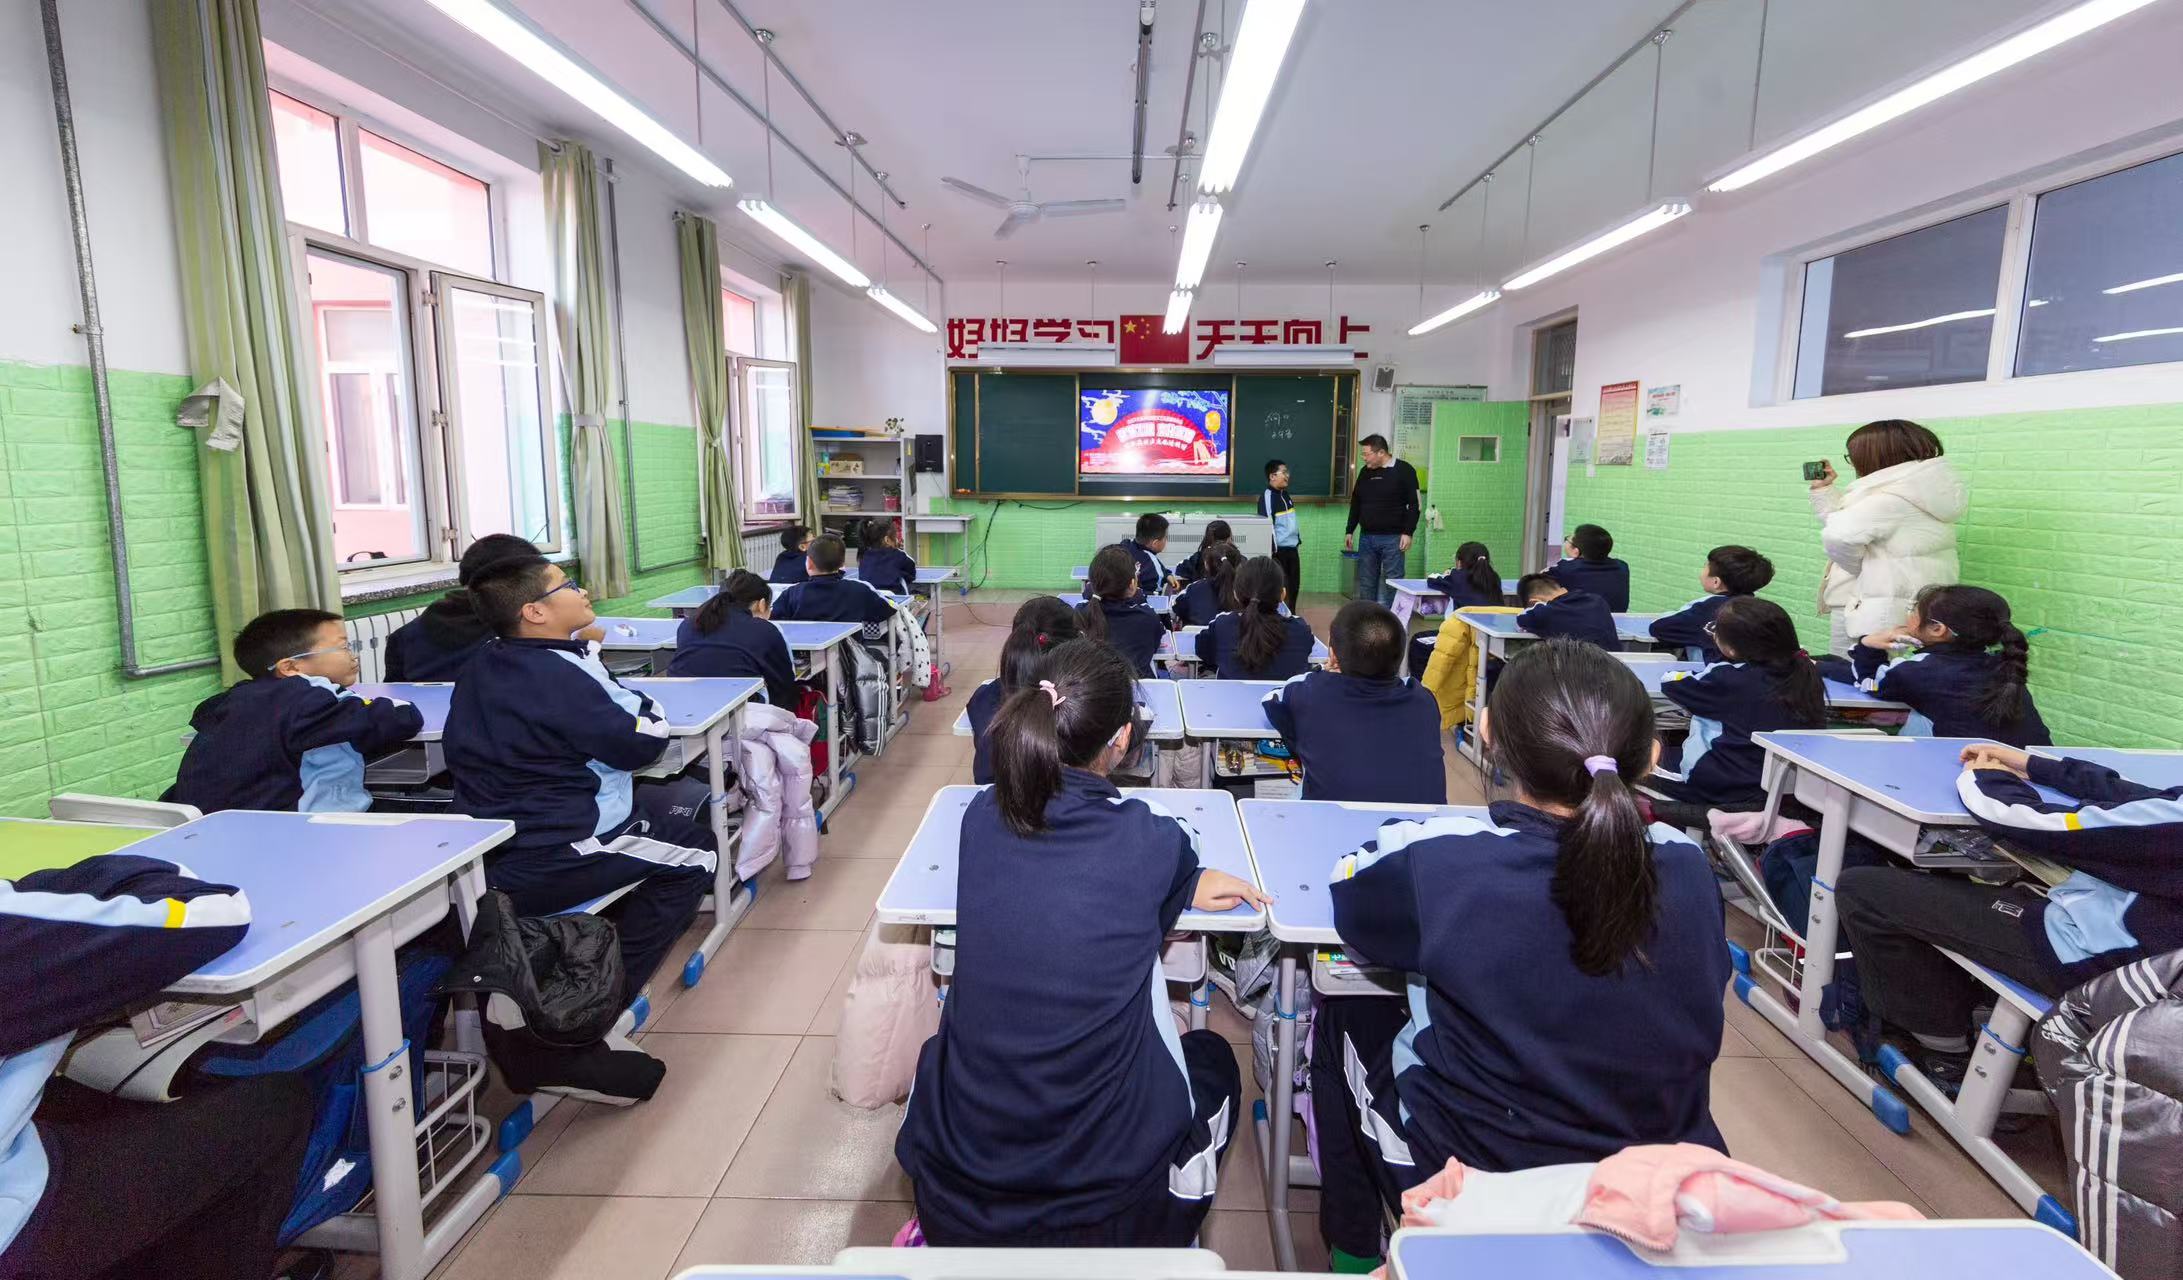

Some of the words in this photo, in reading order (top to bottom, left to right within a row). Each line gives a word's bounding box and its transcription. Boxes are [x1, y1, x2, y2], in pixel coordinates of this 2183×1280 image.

[947, 318, 1114, 358] 好好学习
[1196, 316, 1370, 360] 天天向上
